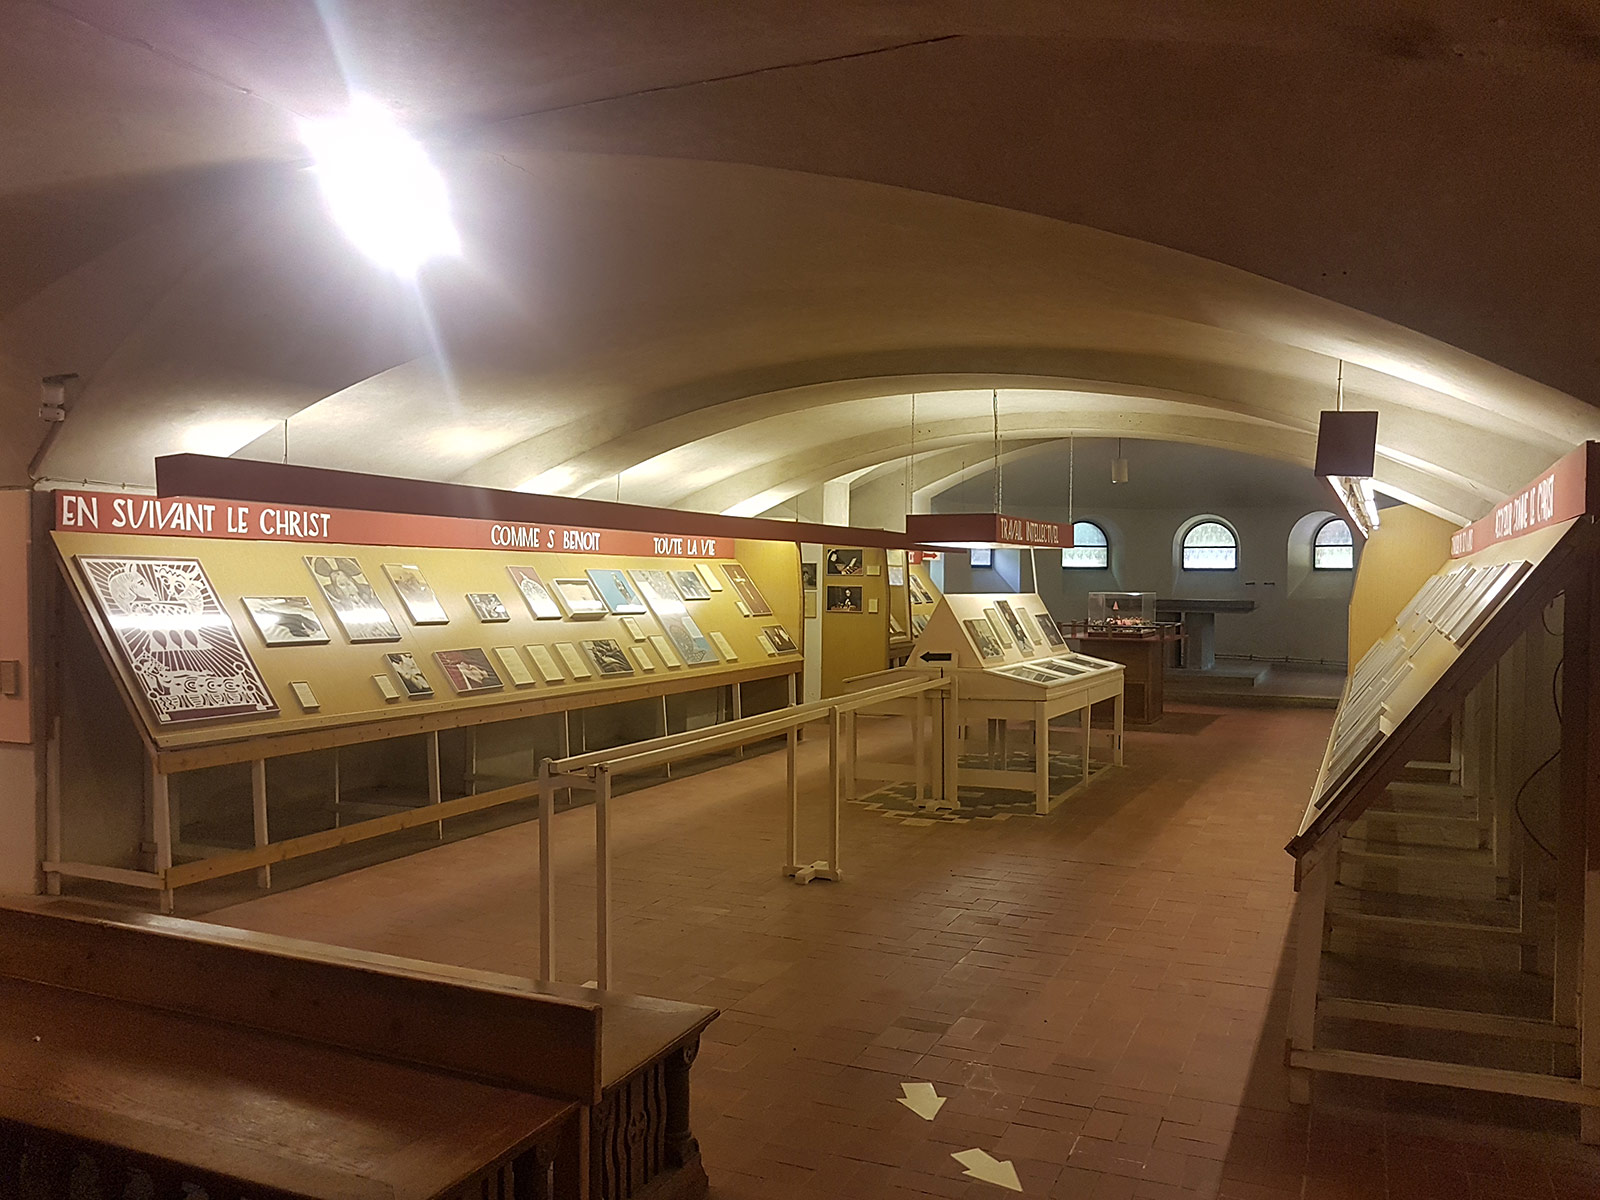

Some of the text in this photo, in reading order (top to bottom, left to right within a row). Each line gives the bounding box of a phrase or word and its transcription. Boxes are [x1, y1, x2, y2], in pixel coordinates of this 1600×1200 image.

[62, 495, 331, 538] EN SUIVANT LE CHRIST
[490, 524, 600, 551] COMME S BENOIT
[653, 537, 716, 556] TOUTE LA VIE
